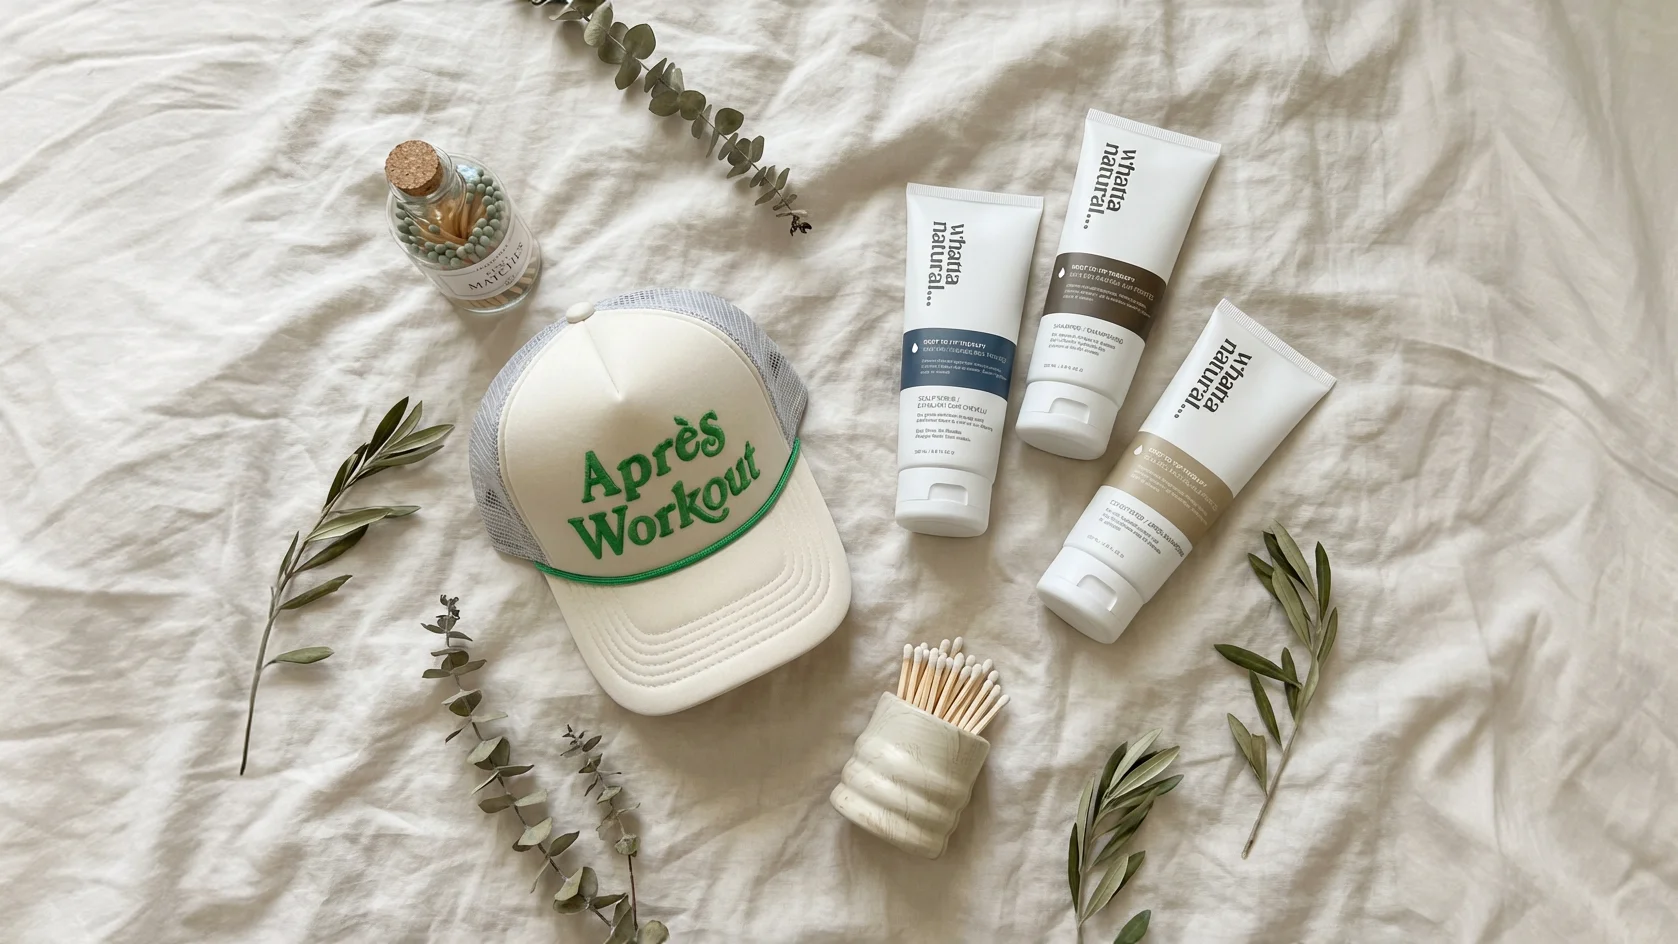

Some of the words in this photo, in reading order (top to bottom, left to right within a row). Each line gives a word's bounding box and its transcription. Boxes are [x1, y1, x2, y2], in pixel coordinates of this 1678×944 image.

[1106, 150, 1137, 212] whatta
[945, 223, 966, 285] whatta
[1202, 352, 1253, 413] whatta
[581, 410, 726, 503] Après
[567, 441, 761, 560] Workout
